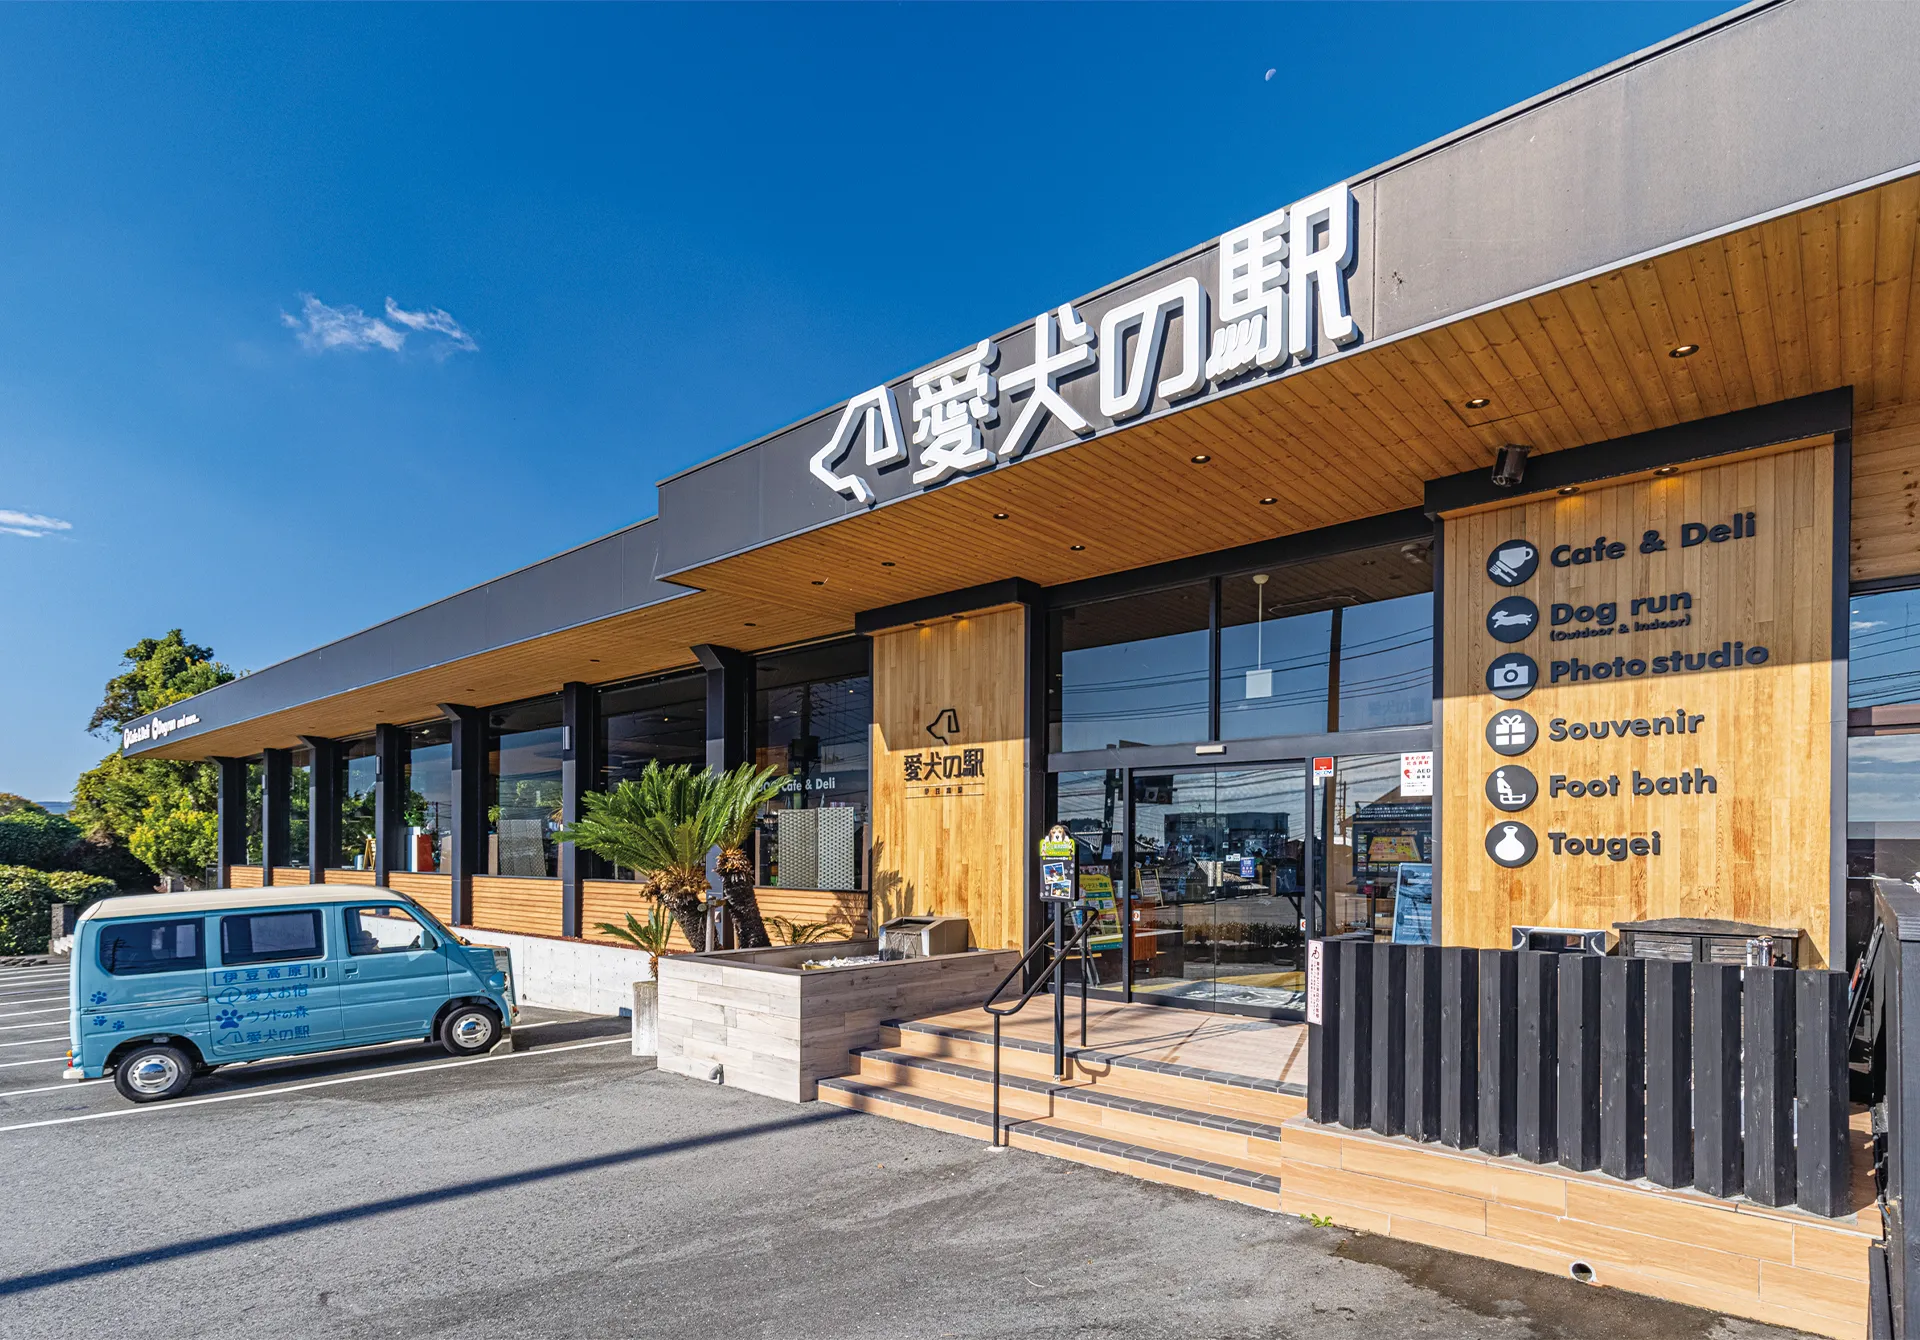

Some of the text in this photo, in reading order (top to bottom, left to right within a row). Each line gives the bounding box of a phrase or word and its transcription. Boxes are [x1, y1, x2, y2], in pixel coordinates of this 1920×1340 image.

[912, 181, 1358, 486] 愛犬の駅
[1550, 511, 1756, 568] Cafe & Deli
[1550, 591, 1692, 627] Dog run
[1549, 613, 1692, 641] (Outdoor & Indoor)
[1548, 708, 1705, 742] Souvenir
[903, 748, 985, 782] 愛犬の駅
[804, 778, 812, 790] &
[815, 776, 836, 790] Deli
[1549, 768, 1718, 798] Foot bath
[1548, 831, 1661, 861] Tougei
[223, 964, 302, 983] 伊豆高原
[245, 983, 308, 1002] 愛犬お宿
[246, 1024, 310, 1045] 愛犬の駅
